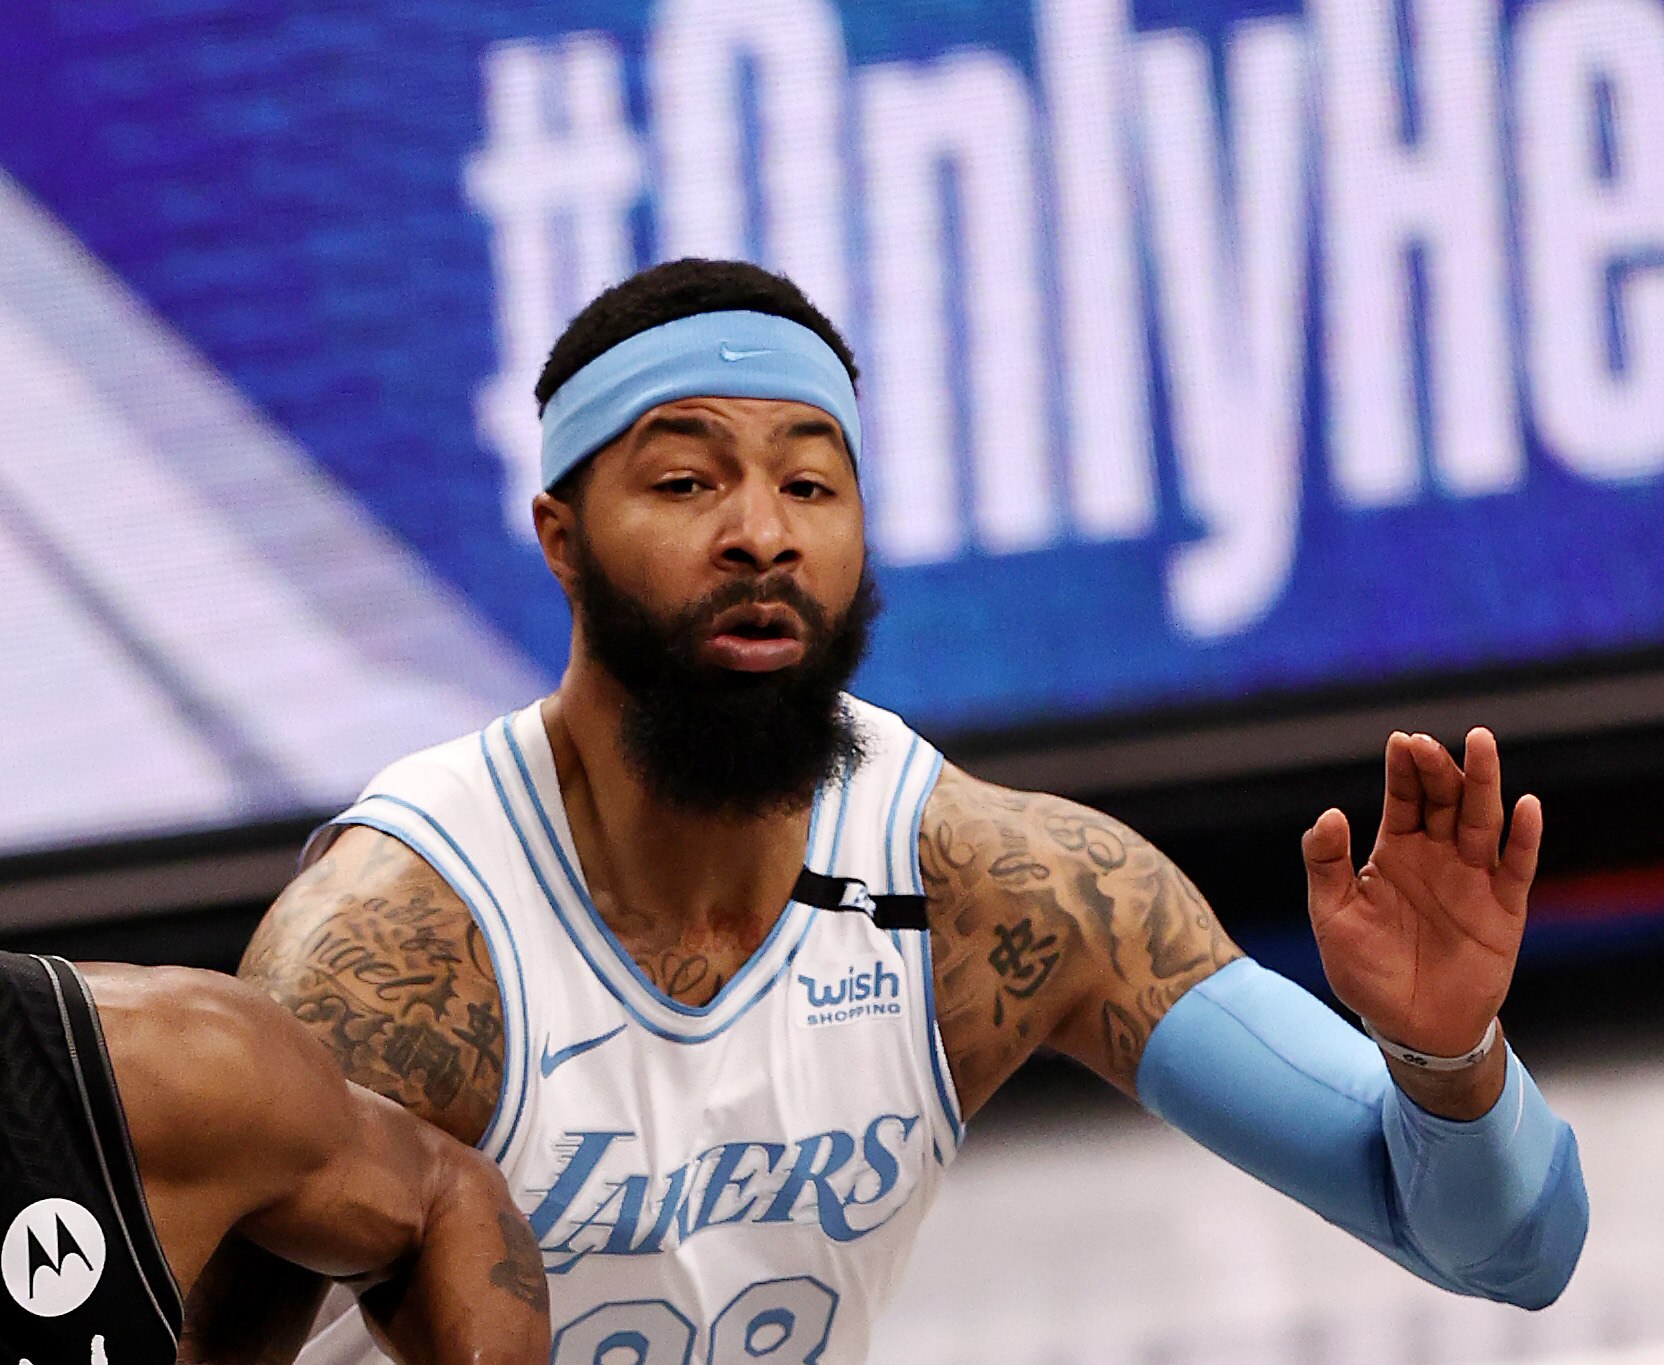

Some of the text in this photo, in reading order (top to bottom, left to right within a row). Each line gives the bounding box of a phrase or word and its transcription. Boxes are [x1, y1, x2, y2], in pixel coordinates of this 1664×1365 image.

[798, 960, 900, 1007] wish
[806, 1002, 902, 1026] SHOPPING
[526, 1113, 920, 1274] LAKERS
